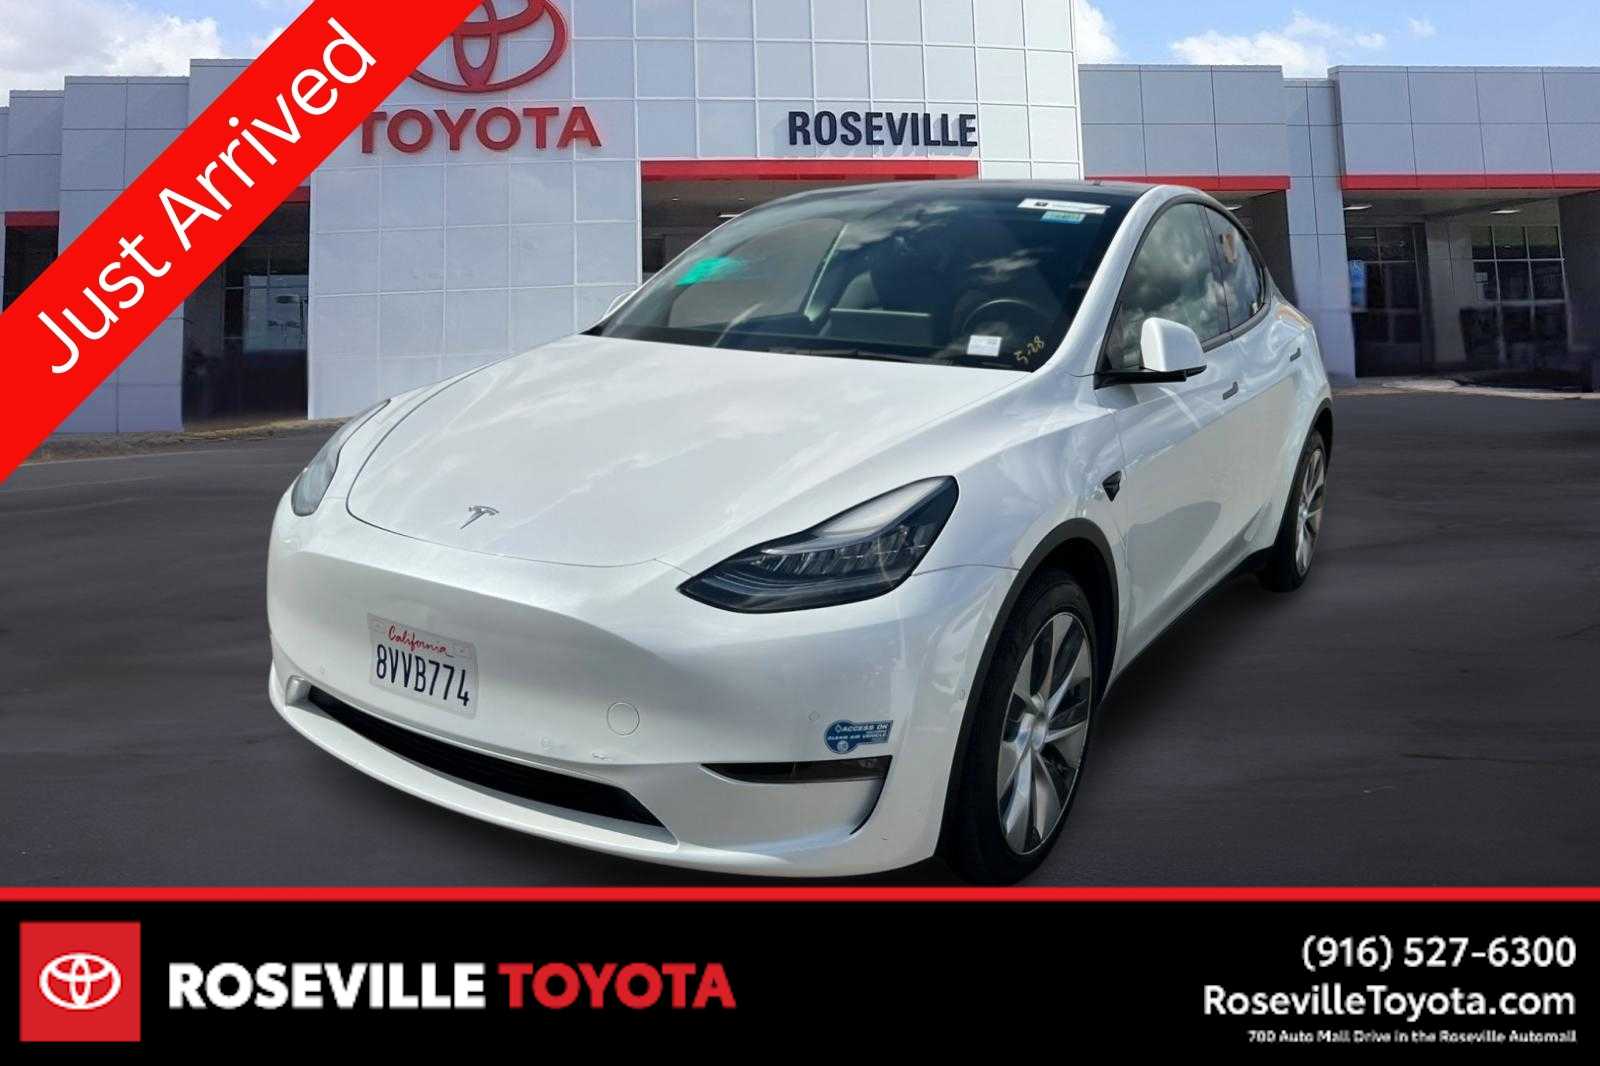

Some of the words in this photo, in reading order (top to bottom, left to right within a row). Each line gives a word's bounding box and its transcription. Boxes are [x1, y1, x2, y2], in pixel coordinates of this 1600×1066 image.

[361, 106, 602, 154] TOYOTA
[788, 112, 978, 146] ROSEVILLE
[387, 624, 453, 657] California
[376, 644, 469, 706] 8VVB774
